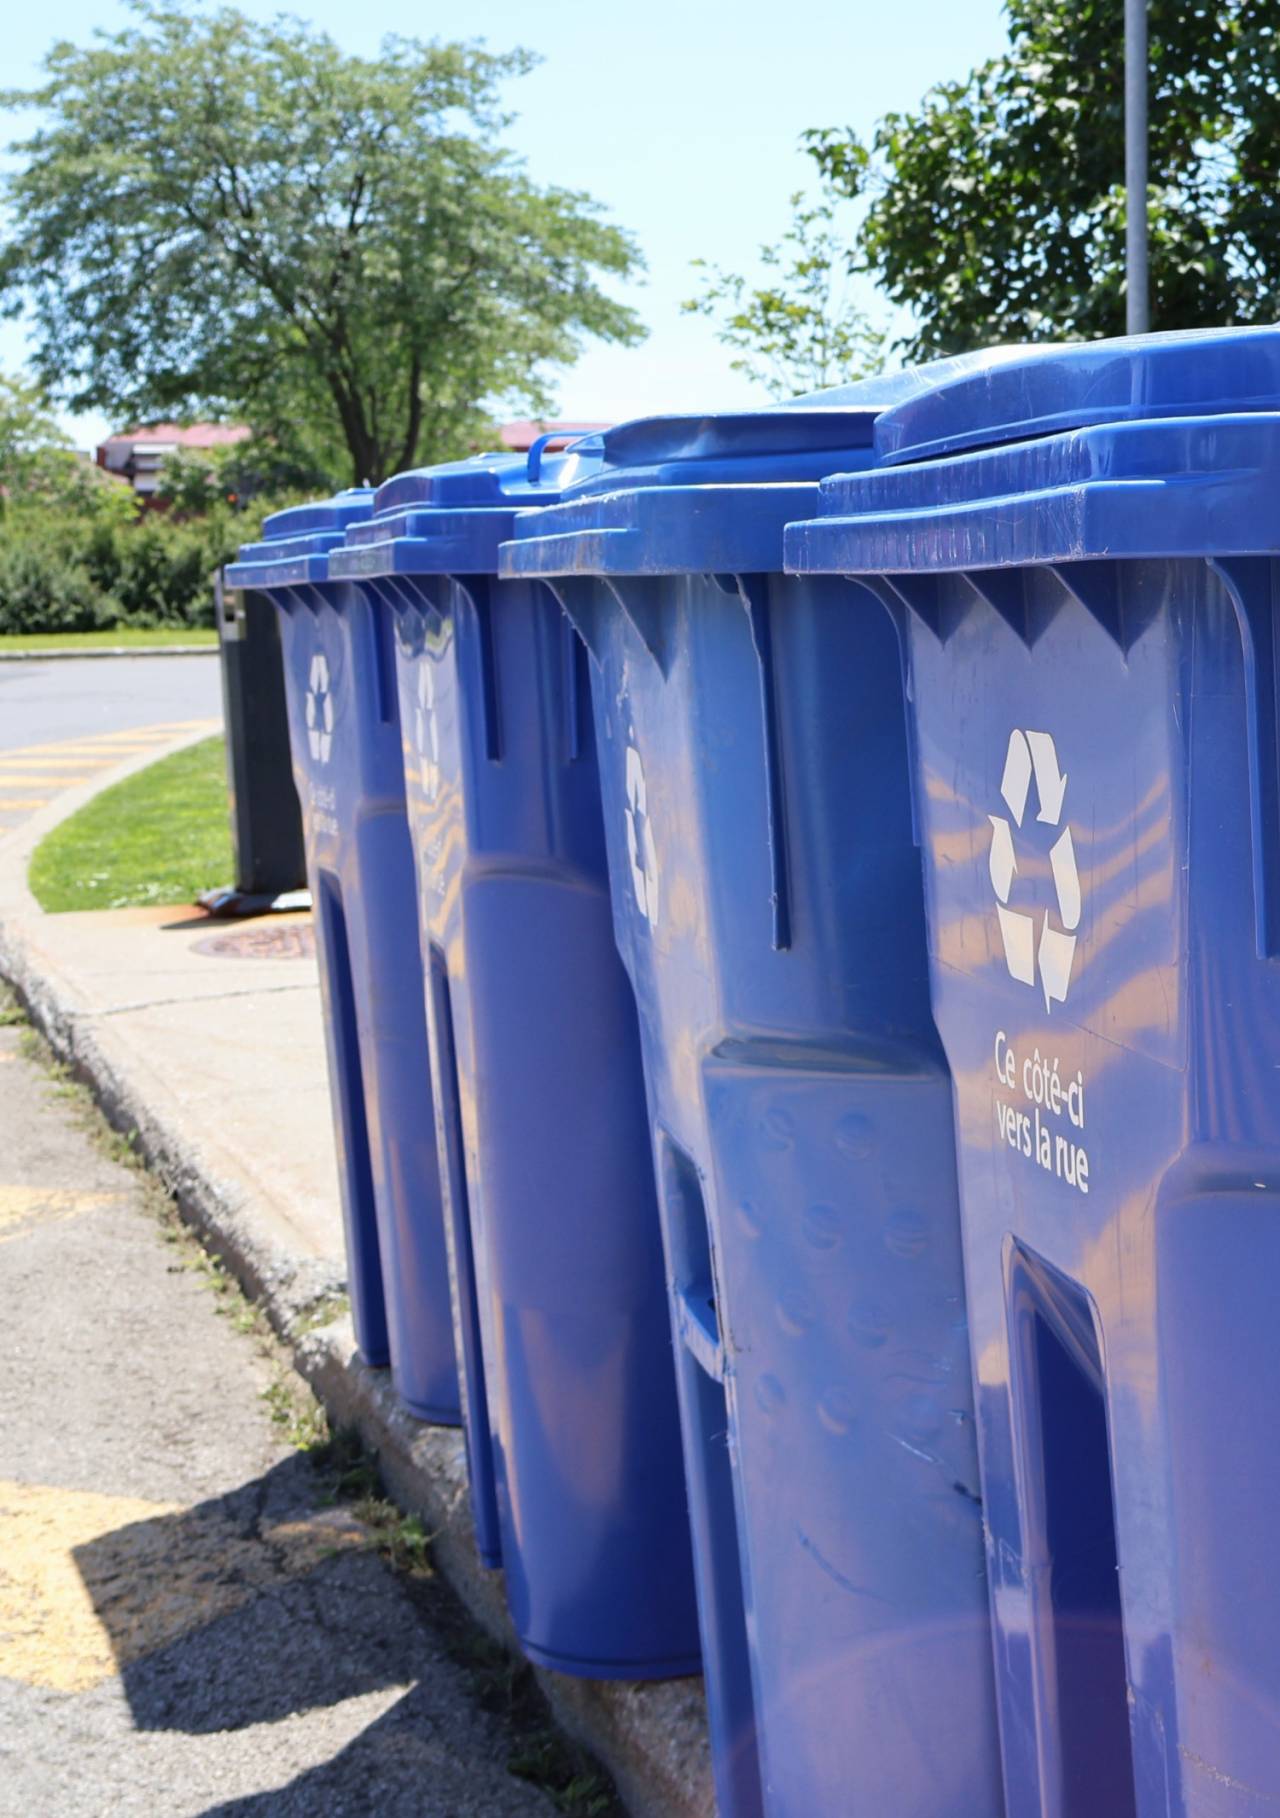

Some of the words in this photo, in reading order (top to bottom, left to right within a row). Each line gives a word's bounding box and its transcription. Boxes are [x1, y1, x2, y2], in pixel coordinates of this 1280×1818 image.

[995, 1031, 1016, 1088] Ce
[1023, 1048, 1084, 1128] côté-ci
[996, 1100, 1032, 1157] vers
[1035, 1108, 1052, 1171] la
[1056, 1134, 1089, 1193] rue
